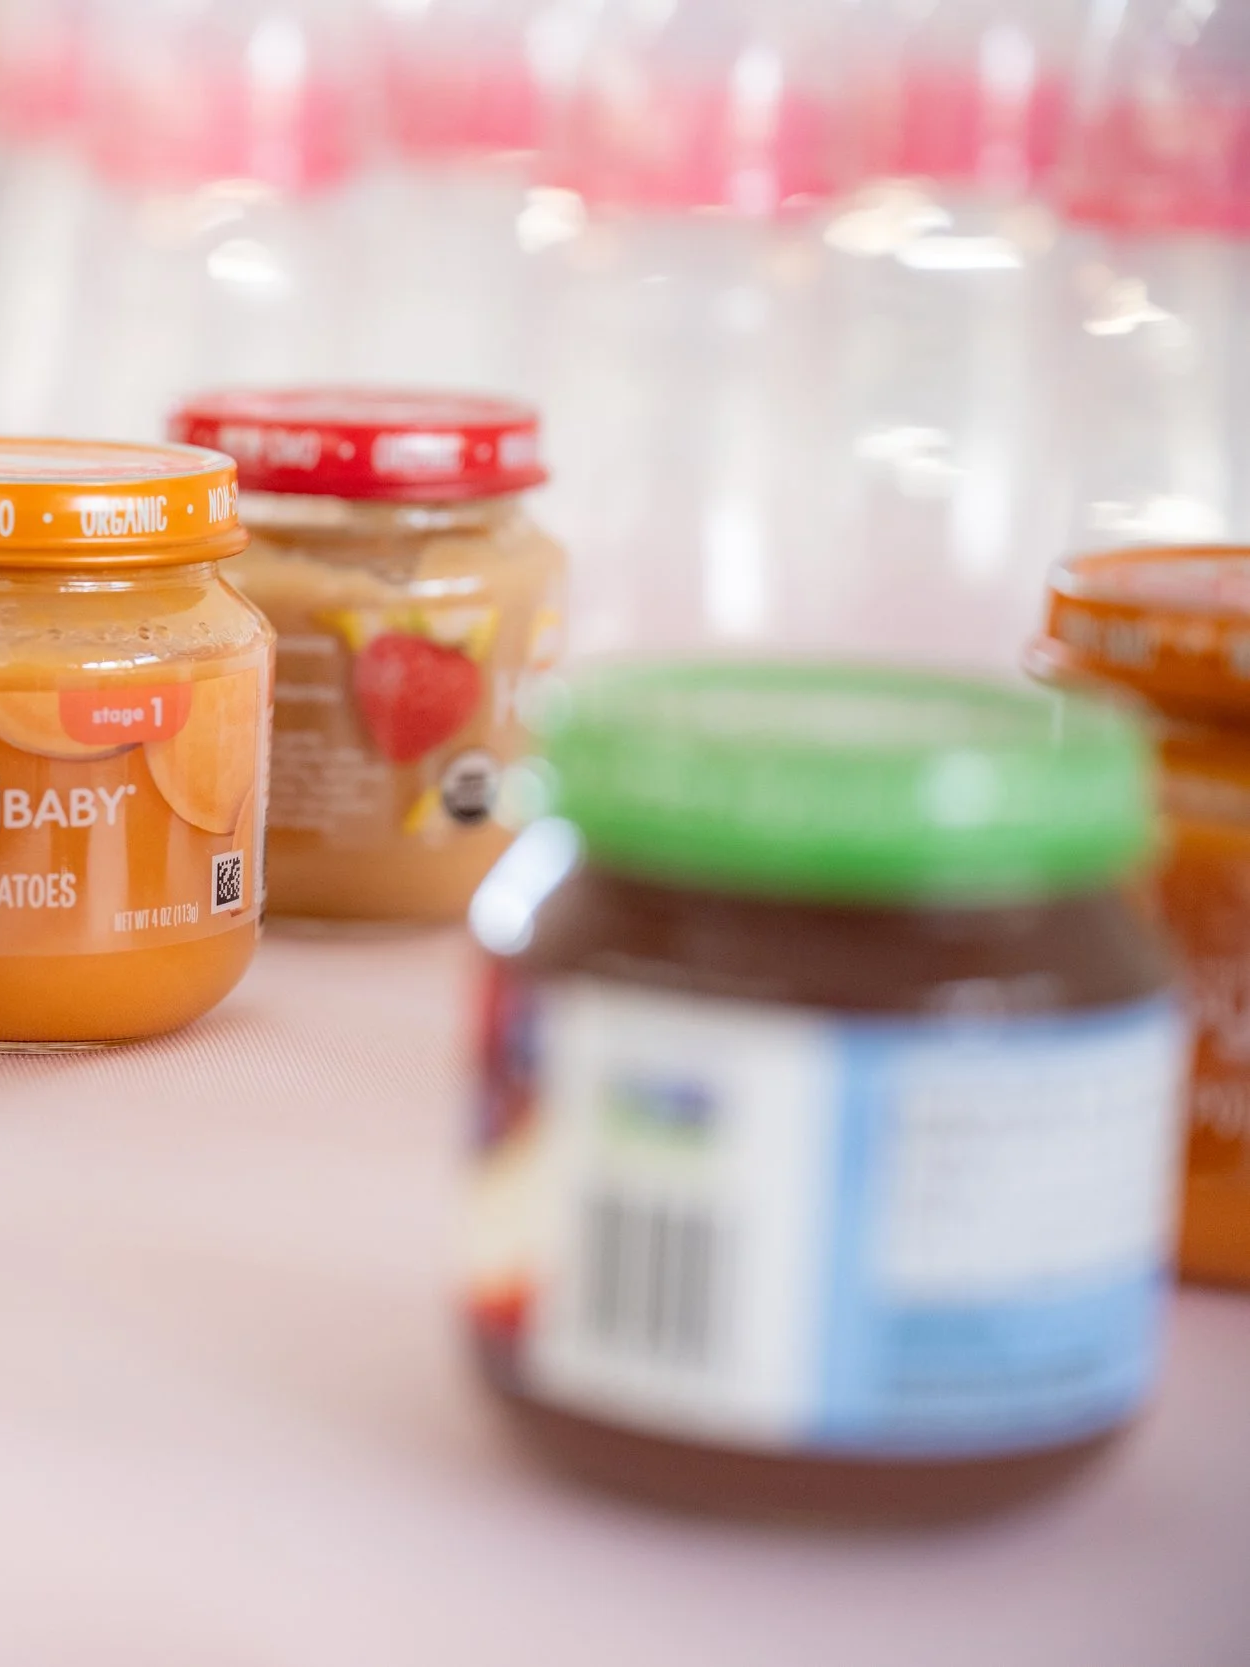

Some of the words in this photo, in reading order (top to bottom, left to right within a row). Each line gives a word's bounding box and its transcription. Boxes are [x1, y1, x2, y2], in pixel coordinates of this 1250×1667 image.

[81, 495, 168, 537] ORGANIC
[92, 707, 145, 727] stage
[151, 697, 163, 727] 1
[114, 911, 133, 932] NET
[135, 911, 150, 930] WT
[152, 908, 159, 928] 4
[160, 906, 172, 927] OZ
[174, 902, 199, 926] (113g)
